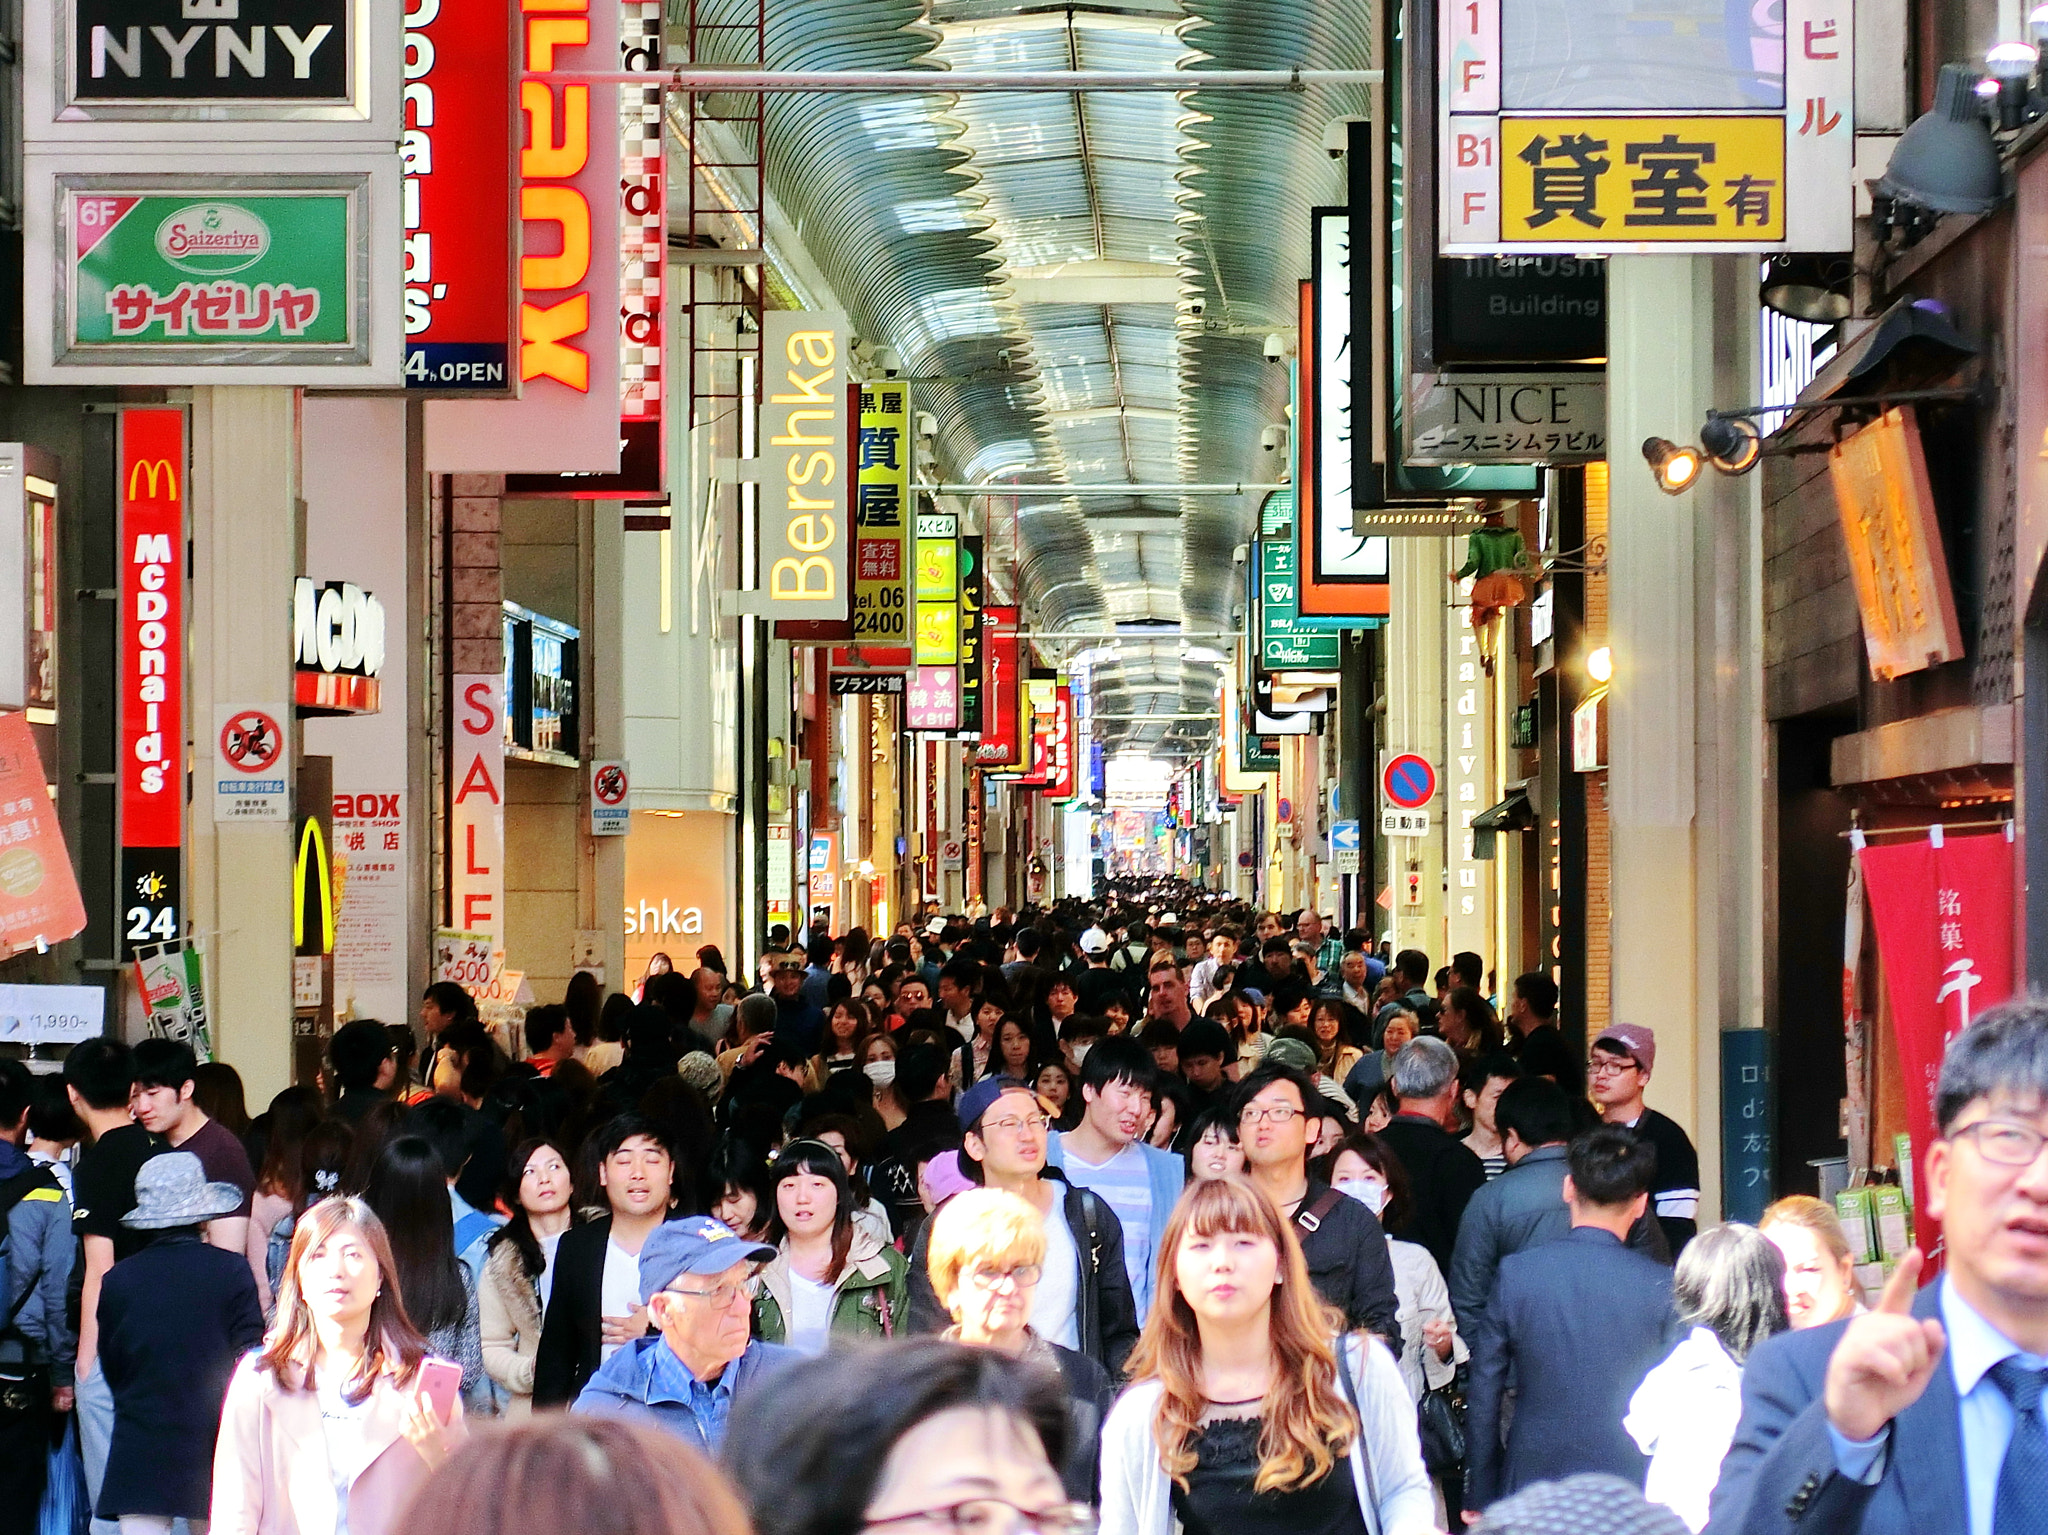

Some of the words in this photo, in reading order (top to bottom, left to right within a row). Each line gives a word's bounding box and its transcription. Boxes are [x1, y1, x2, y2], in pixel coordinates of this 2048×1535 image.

[91, 25, 333, 79] NYNY
[1798, 19, 1842, 137] ビル
[80, 201, 116, 226] 6F
[168, 224, 260, 258] Saizeriya
[110, 284, 316, 332] サイゼリヤ
[1489, 295, 1600, 317] Building
[440, 363, 503, 382] OPEN
[1454, 387, 1571, 424] NICE
[771, 330, 836, 600] Bershka
[857, 427, 900, 527] 質屋
[863, 543, 896, 559] 査定
[863, 560, 896, 577] 無料
[880, 587, 904, 608] 06
[855, 612, 904, 633] 2400
[133, 534, 173, 795] McDonald's
[909, 689, 953, 708] 韓流
[927, 713, 953, 725] B1F
[1384, 816, 1427, 830] 自動車
[126, 906, 177, 941] 24
[624, 899, 703, 934] shka
